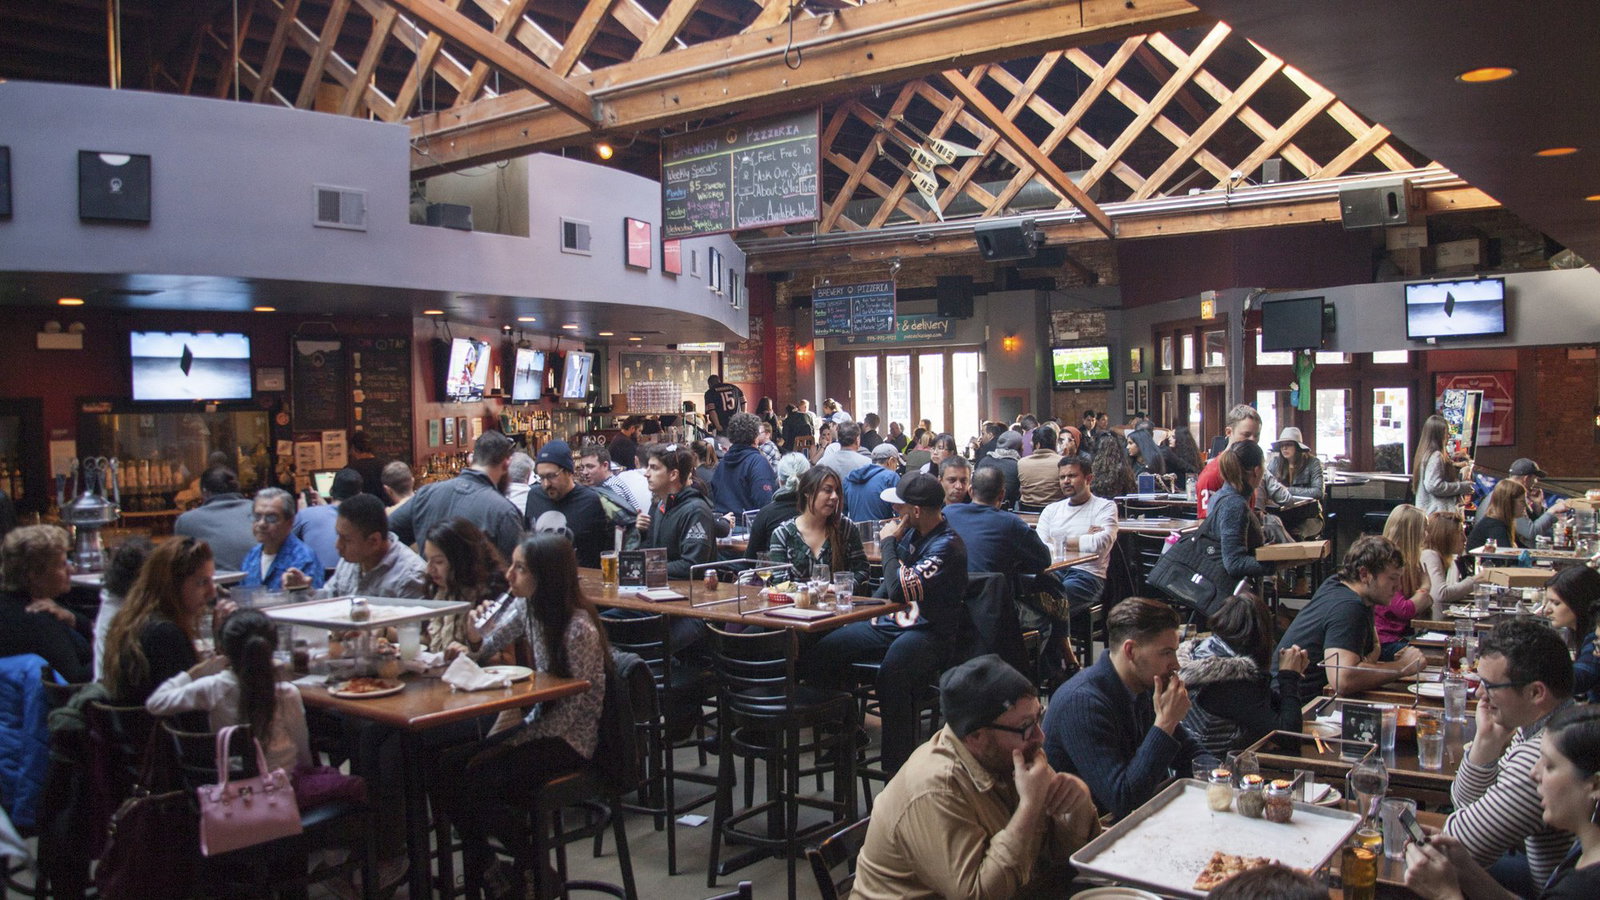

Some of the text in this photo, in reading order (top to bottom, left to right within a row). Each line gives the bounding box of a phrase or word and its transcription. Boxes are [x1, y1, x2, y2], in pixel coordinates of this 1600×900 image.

[746, 125, 800, 143] PIZZERIA
[757, 144, 811, 162] Feel Free To
[666, 168, 690, 182] Weekly
[757, 170, 772, 181] Ask
[690, 180, 701, 193] $5
[818, 284, 889, 297] BREWERY PIZZERIA
[902, 319, 909, 331] &
[911, 318, 949, 333] delivery
[720, 391, 736, 411] 15
[916, 559, 939, 579] 23
